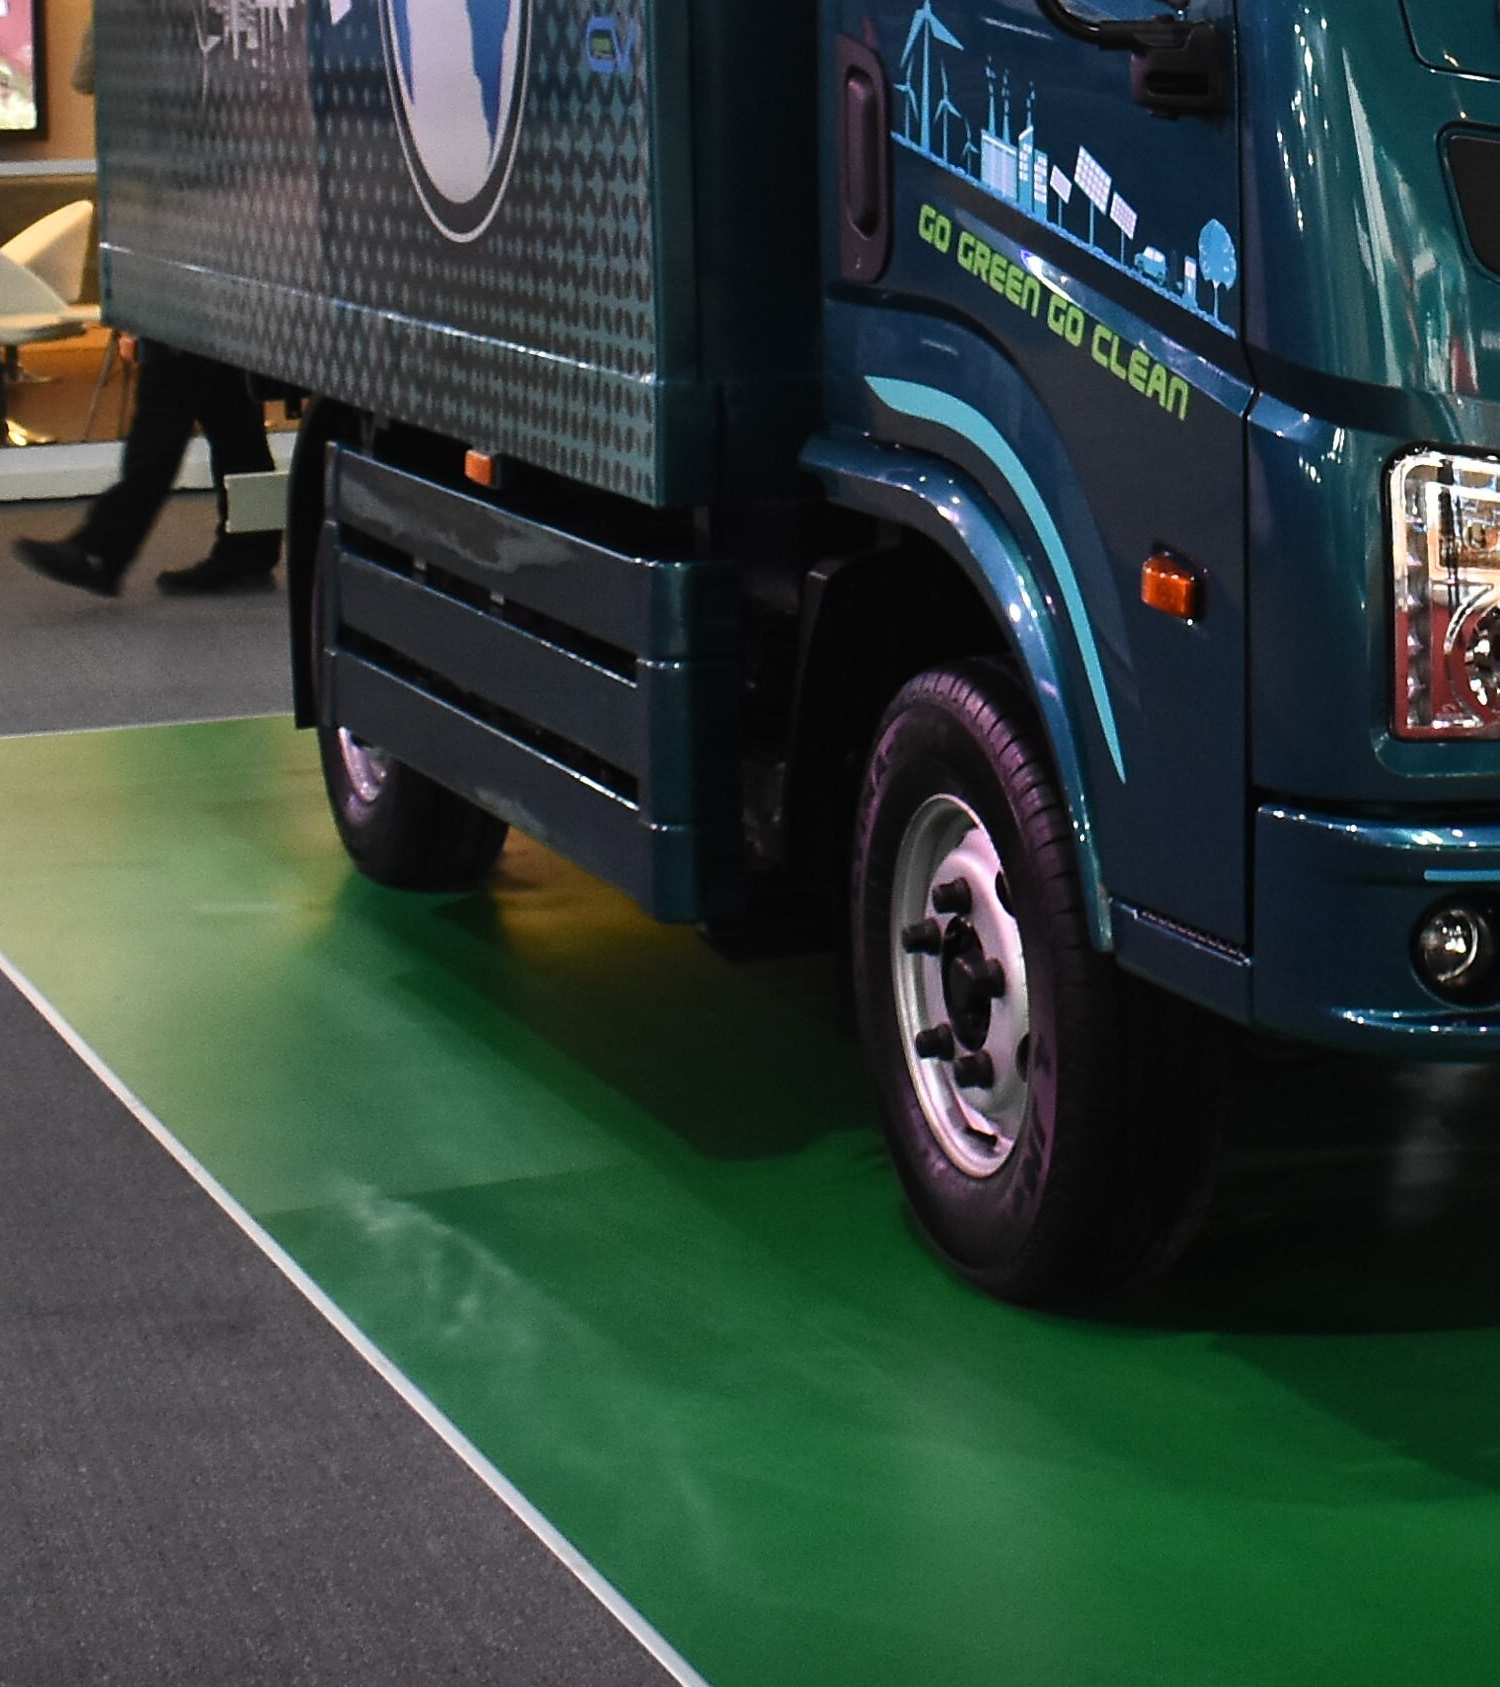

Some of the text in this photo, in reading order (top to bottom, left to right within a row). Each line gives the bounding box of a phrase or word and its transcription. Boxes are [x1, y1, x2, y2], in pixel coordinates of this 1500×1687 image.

[918, 204, 1190, 421] GO GREEN GO CLEAN
